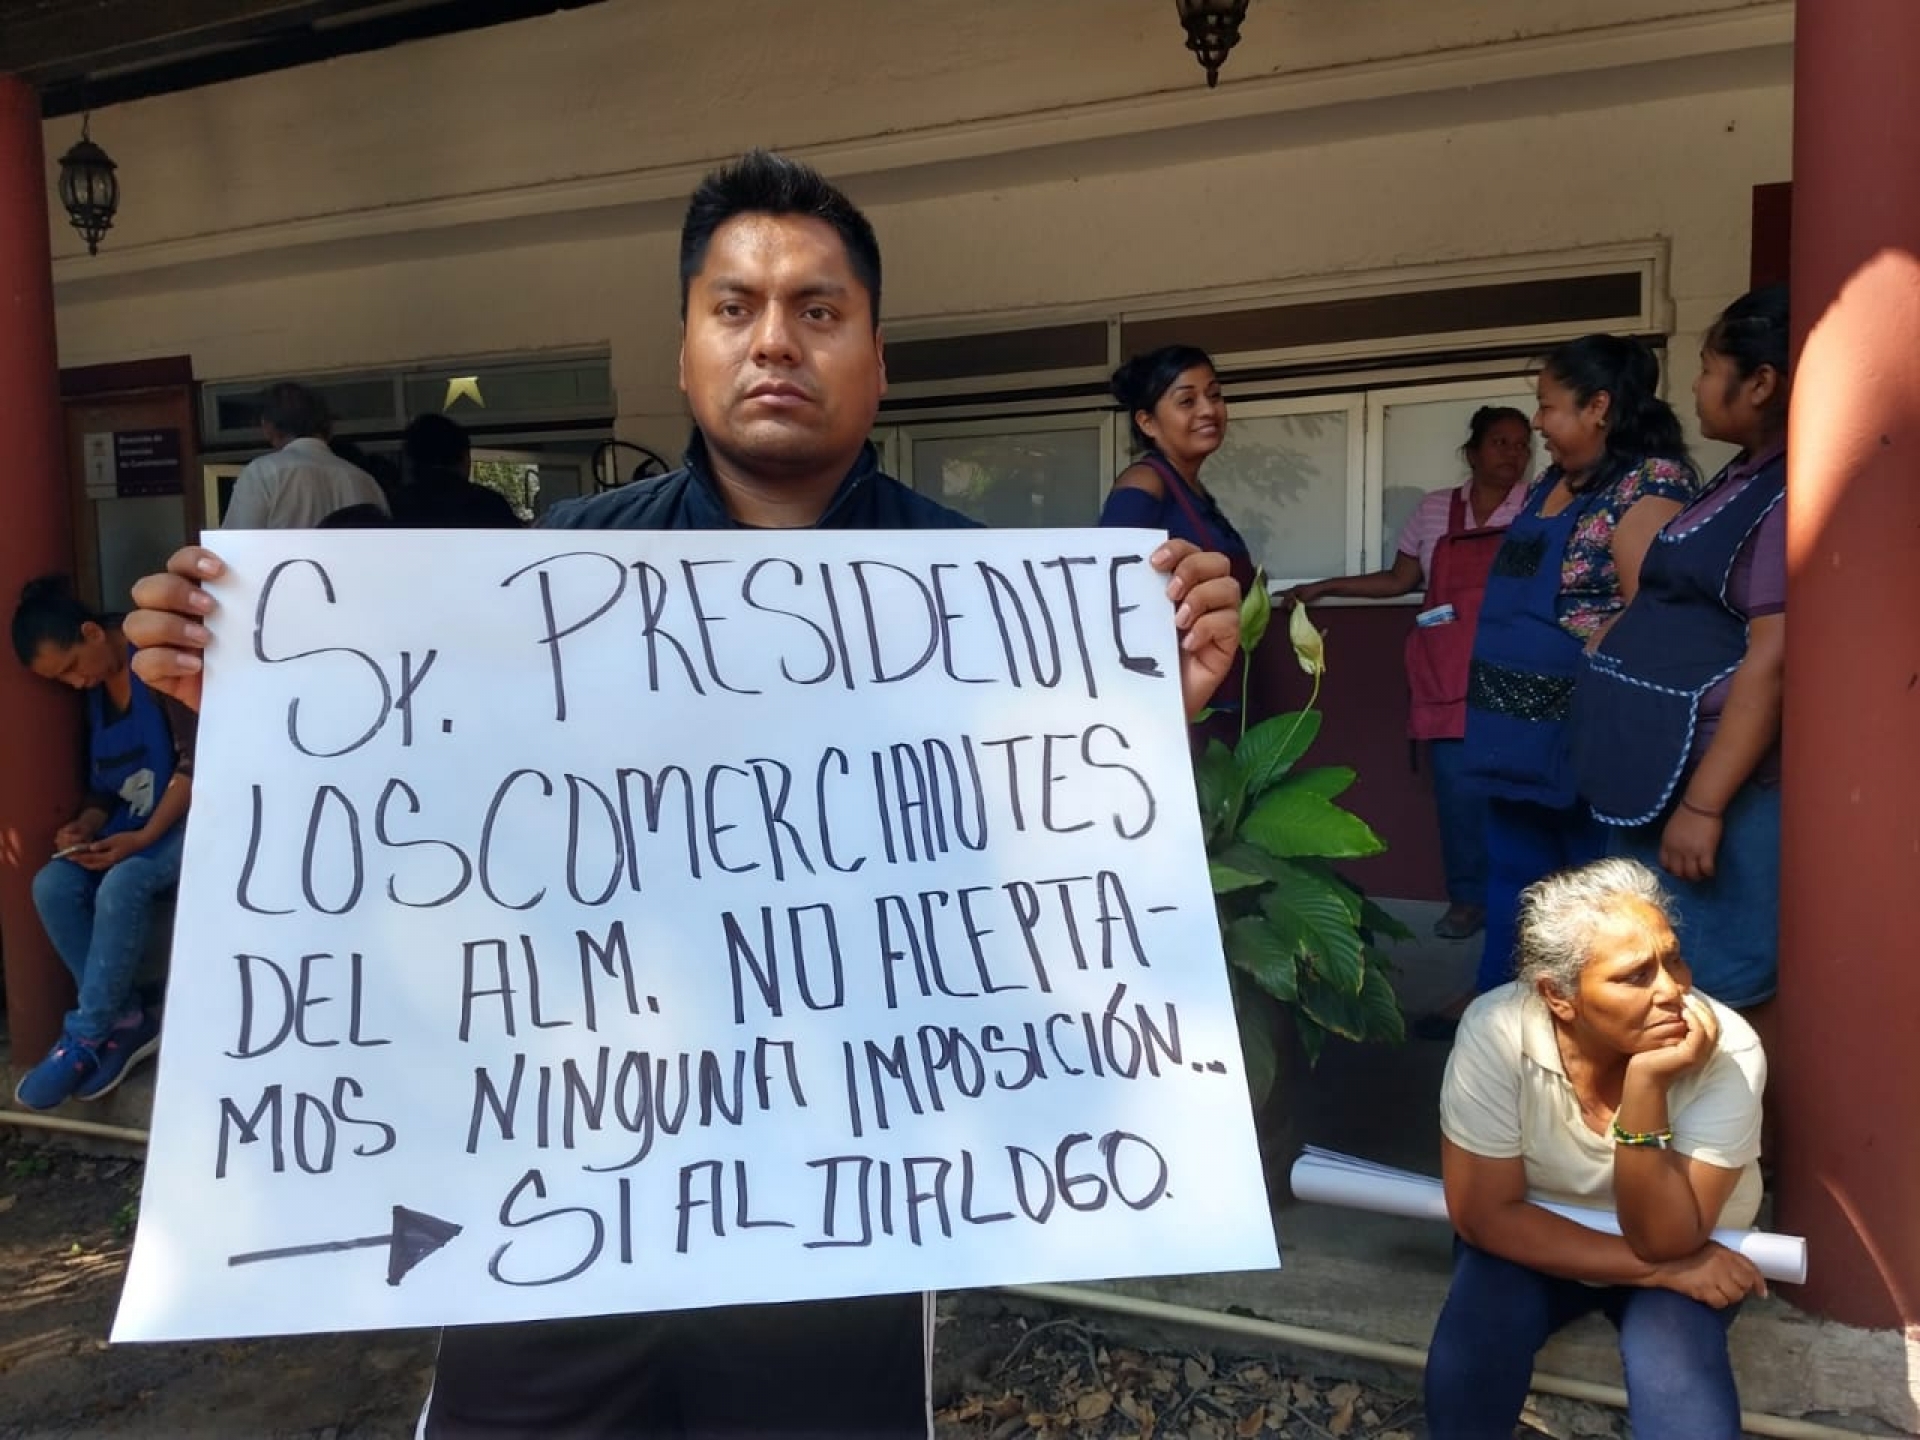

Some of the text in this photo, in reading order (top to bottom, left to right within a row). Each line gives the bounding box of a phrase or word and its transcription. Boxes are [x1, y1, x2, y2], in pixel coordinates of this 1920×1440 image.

[253, 551, 1165, 757] Sr. PRESIDENTE
[224, 869, 1179, 1059] DEL ALM. NO ACEPTA-
[216, 1076, 397, 1179] MOS
[488, 1168, 634, 1286] SI
[675, 1159, 796, 1254] AL
